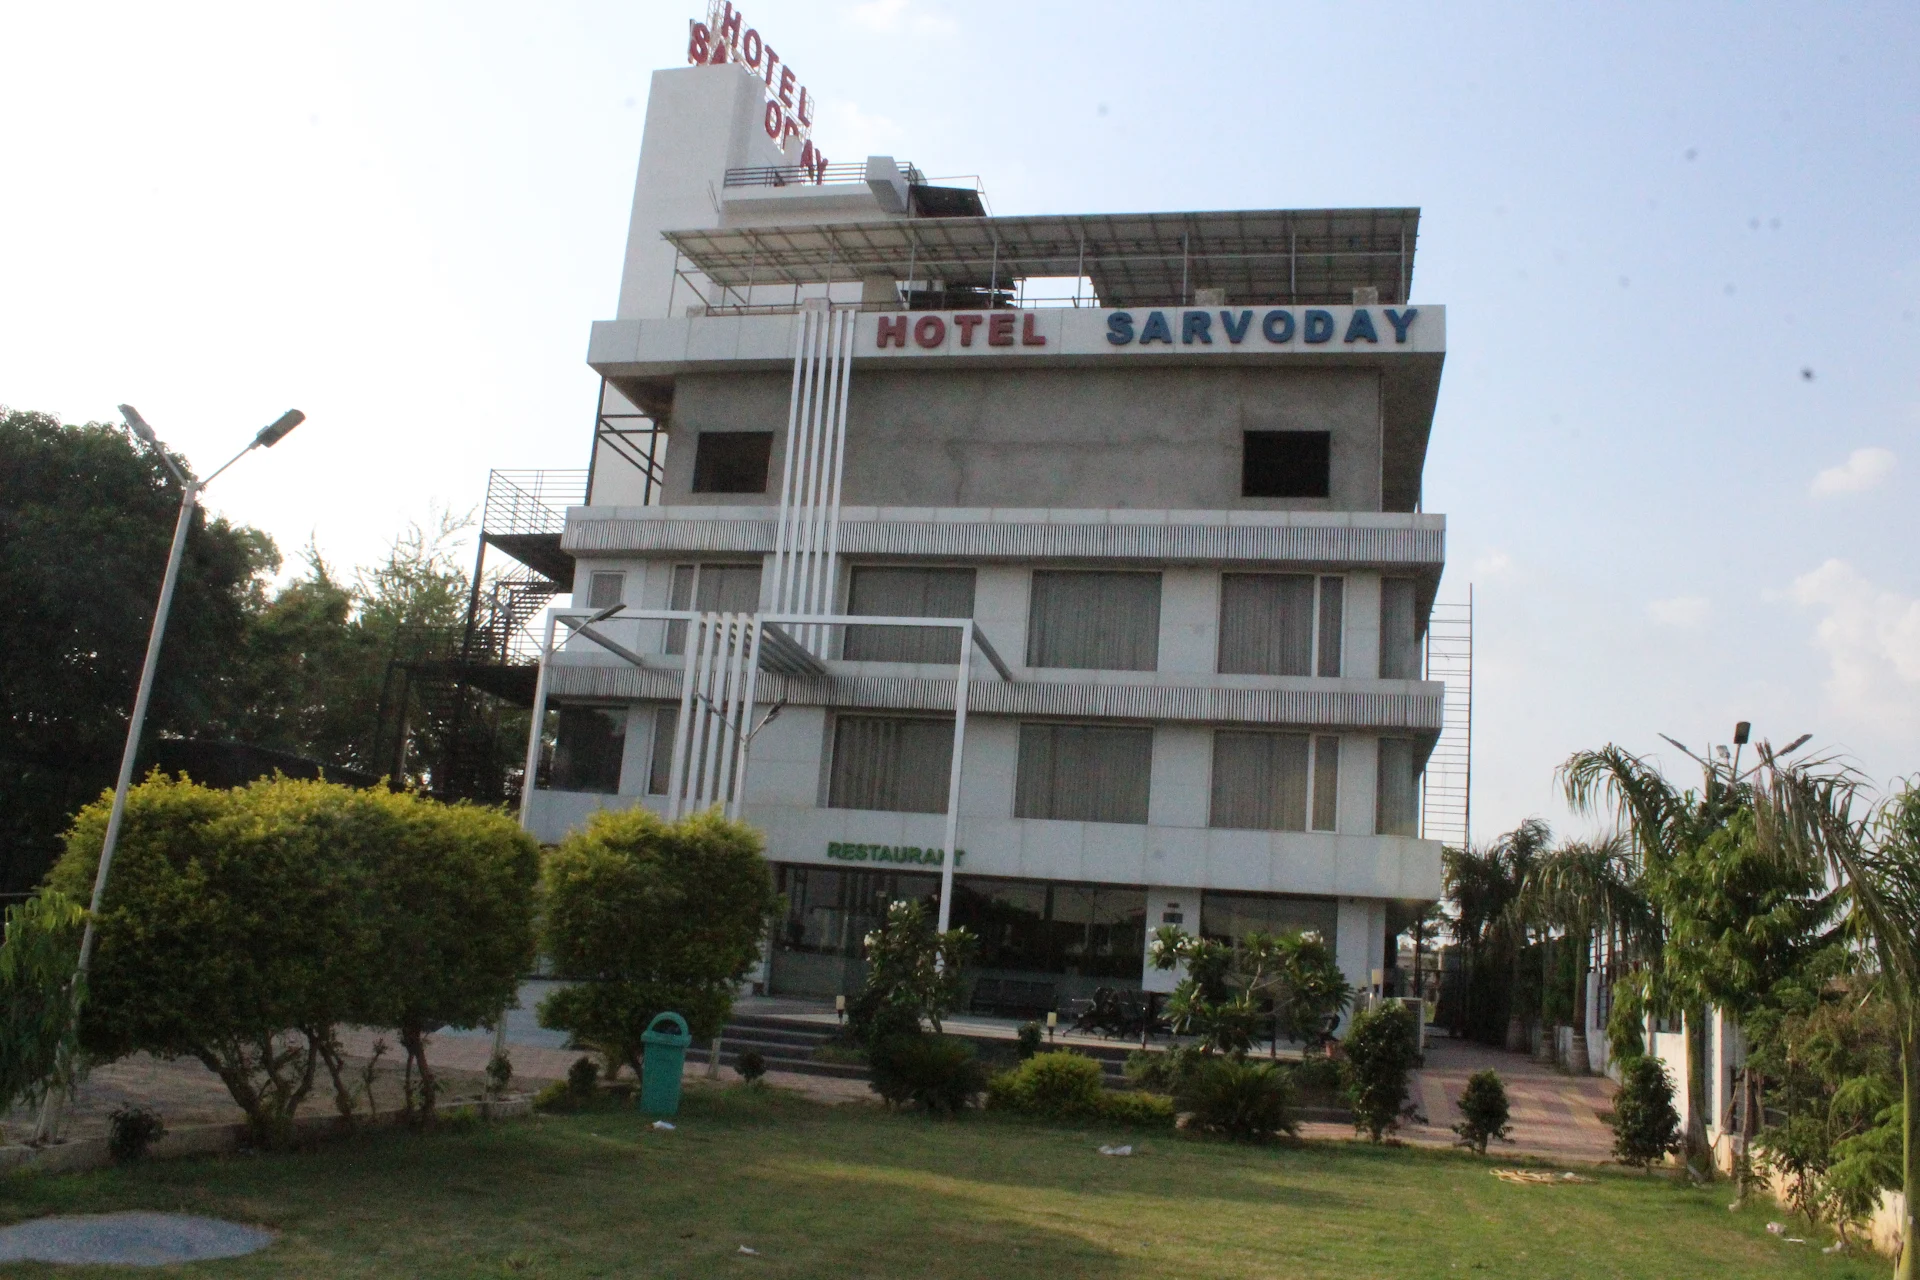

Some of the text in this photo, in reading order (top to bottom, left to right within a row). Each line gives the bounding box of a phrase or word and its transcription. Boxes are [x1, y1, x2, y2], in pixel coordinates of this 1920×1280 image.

[721, 1, 810, 128] HOTEL
[877, 309, 1418, 348] HOTEL SARVODAY
